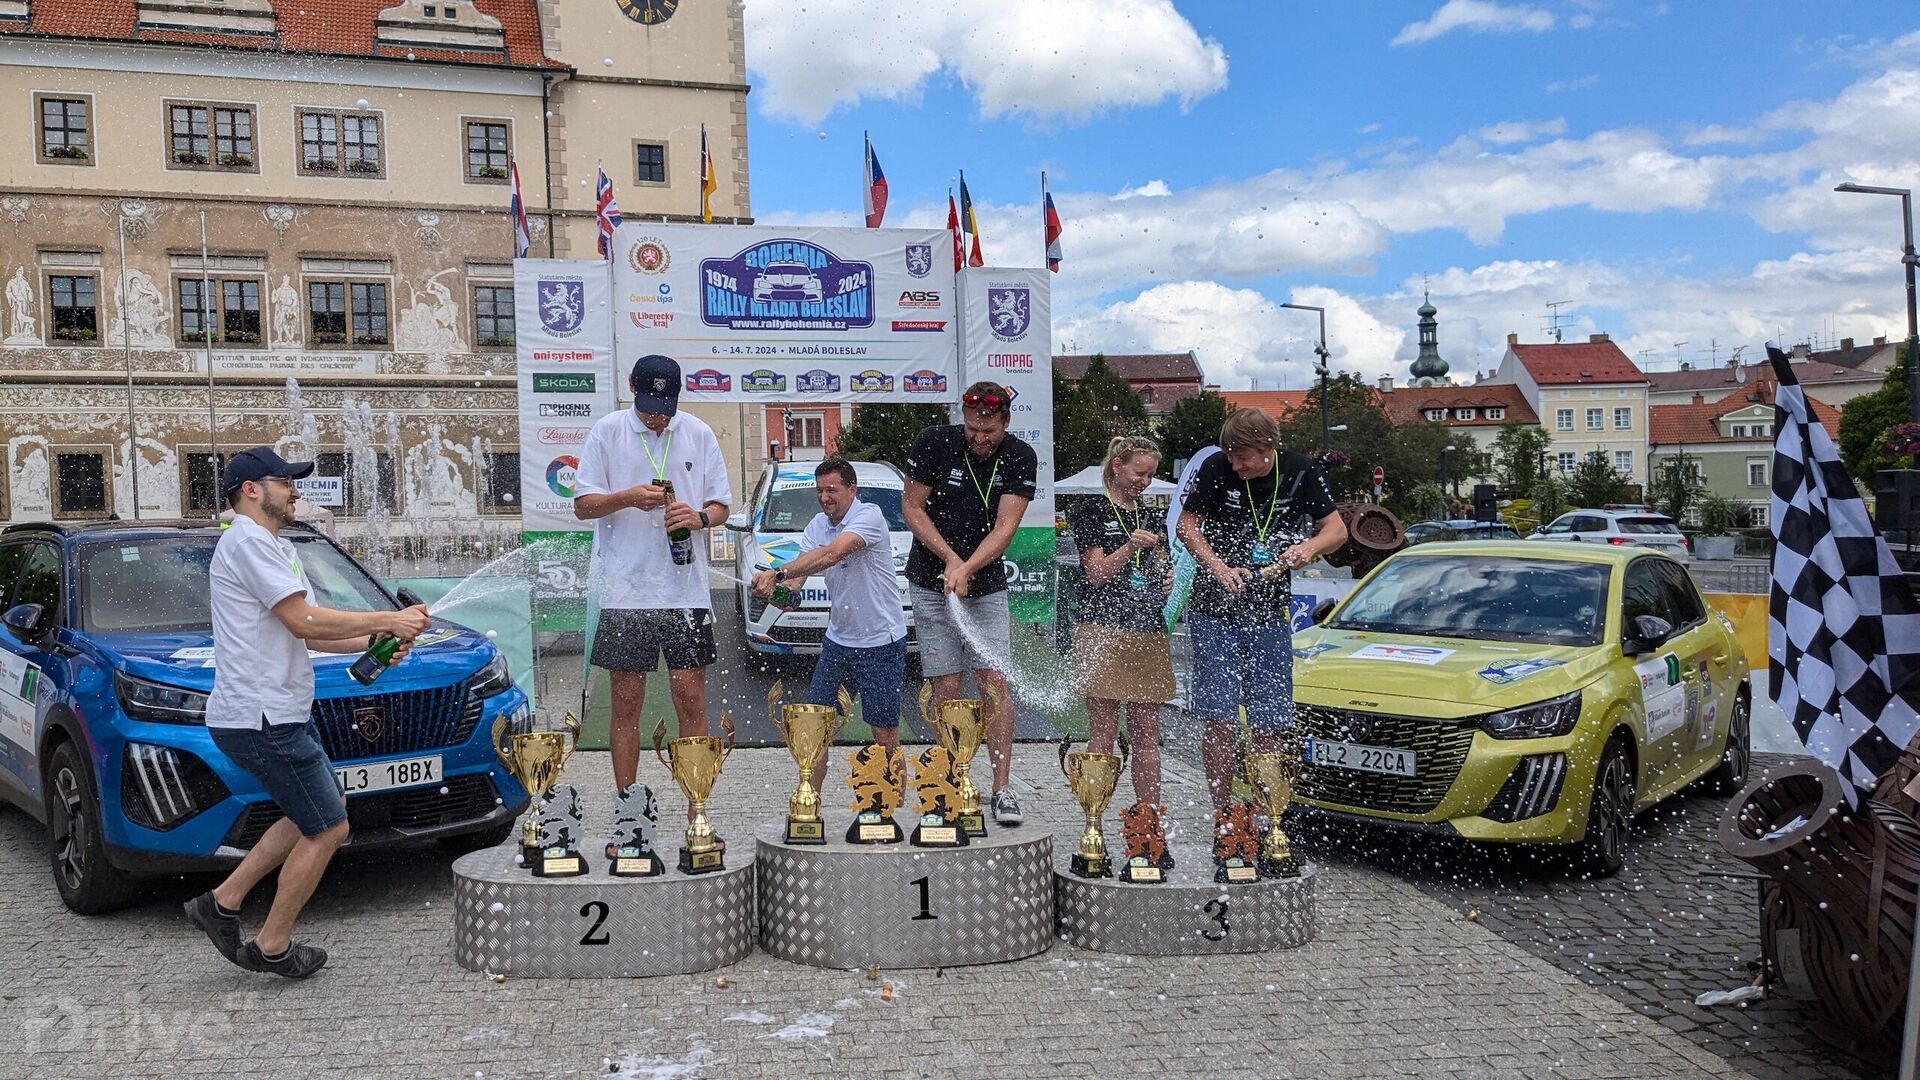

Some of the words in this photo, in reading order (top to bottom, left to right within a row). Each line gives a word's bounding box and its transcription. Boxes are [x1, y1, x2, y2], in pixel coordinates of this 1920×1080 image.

[650, 236, 662, 244] LET
[745, 243, 828, 269] BOHEMIA
[705, 269, 737, 292] 1974
[838, 270, 867, 294] 2024
[707, 284, 748, 316] RALLY
[801, 287, 868, 318] BOLESLAV
[899, 291, 941, 301] ABS
[637, 312, 674, 321] Liberecký
[654, 320, 668, 328] kraj
[732, 320, 846, 329] www.rallybohemia.cz
[560, 328, 582, 338] Boleslav
[711, 346, 720, 354] 6.
[730, 346, 744, 354] 14.
[755, 346, 777, 354] 2024
[788, 345, 820, 355] MLADÁ
[822, 346, 867, 355] BOLESLAV
[533, 351, 593, 362] onisystem
[988, 354, 1033, 367] COMPAG
[559, 472, 576, 481] KM
[535, 502, 573, 510] KULTURA
[1020, 572, 1047, 582] LET
[1024, 584, 1047, 592] Rally
[1316, 743, 1347, 765] EL2
[1361, 749, 1406, 772] 22CA
[337, 769, 369, 791] L3
[386, 760, 433, 785] 18BX
[910, 876, 938, 920] 1
[579, 901, 610, 945] 2
[1202, 897, 1231, 941] 3
